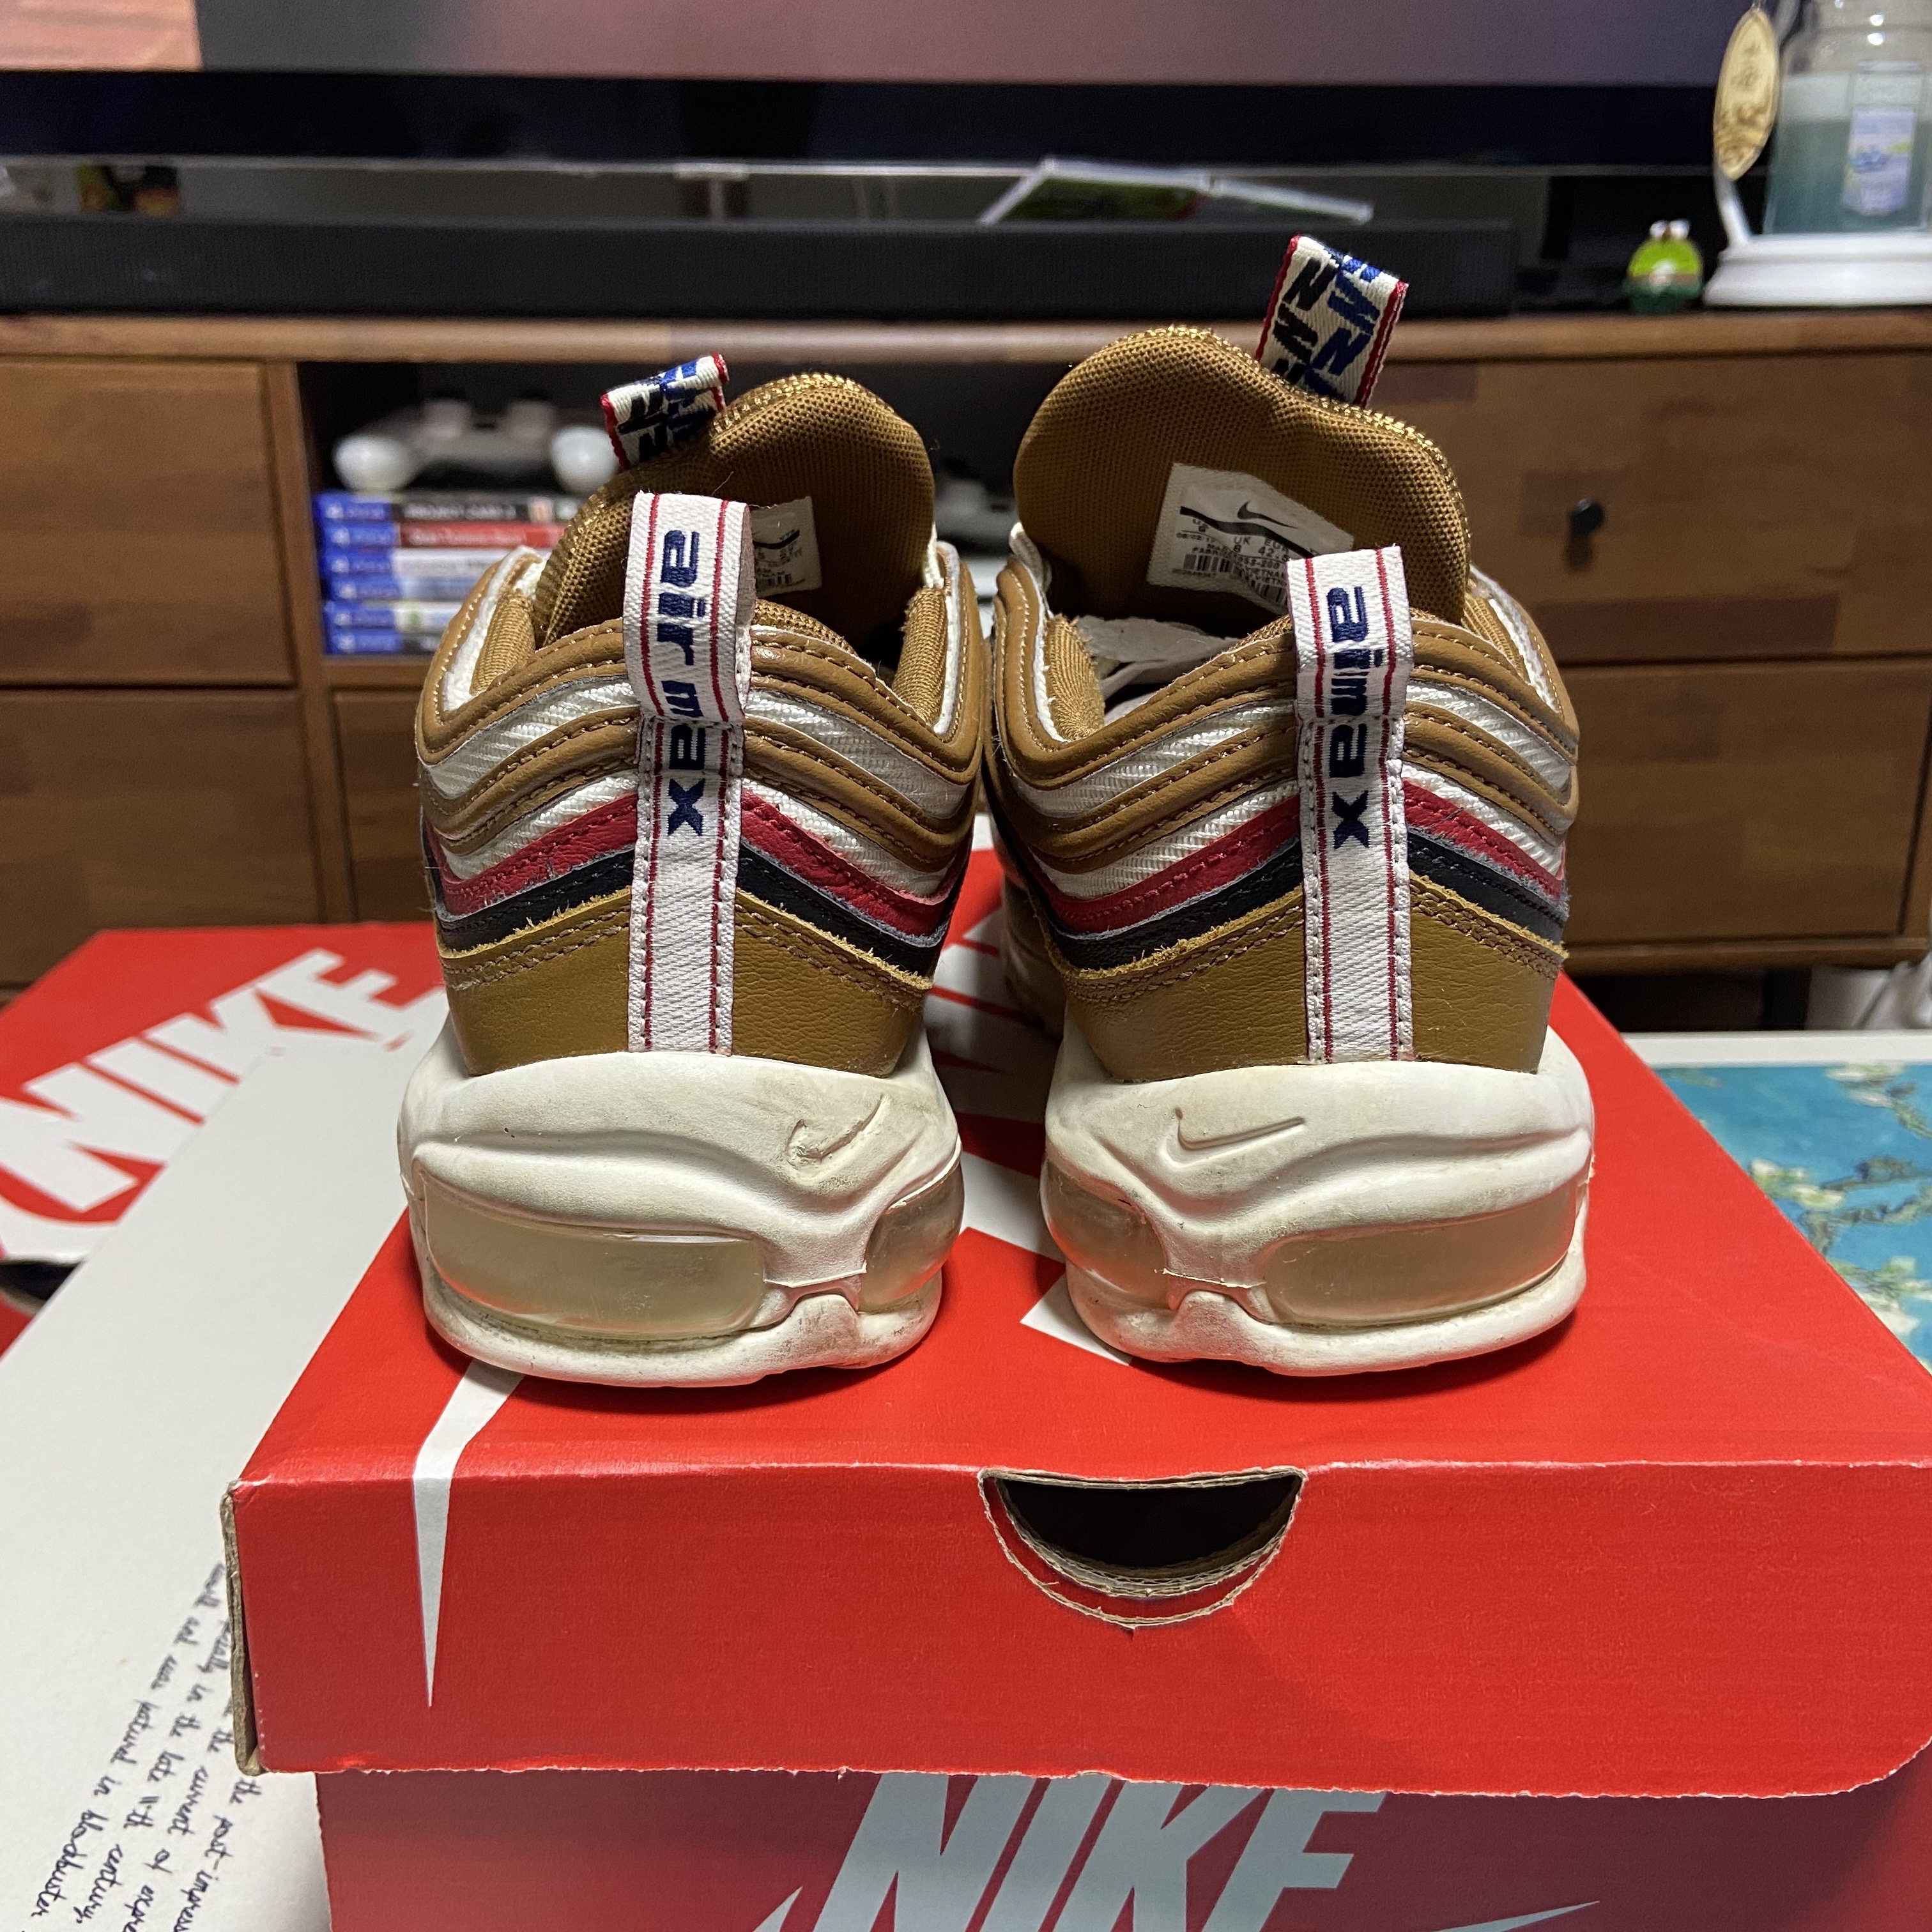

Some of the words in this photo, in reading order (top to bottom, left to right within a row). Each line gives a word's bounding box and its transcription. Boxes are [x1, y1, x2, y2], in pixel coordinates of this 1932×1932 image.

[657, 530, 706, 666] air
[1326, 586, 1383, 676] ai
[661, 680, 705, 836] max
[1330, 677, 1370, 848] max
[93, 1775, 121, 1797] in
[230, 1778, 262, 1804] the
[146, 1848, 172, 1874] of
